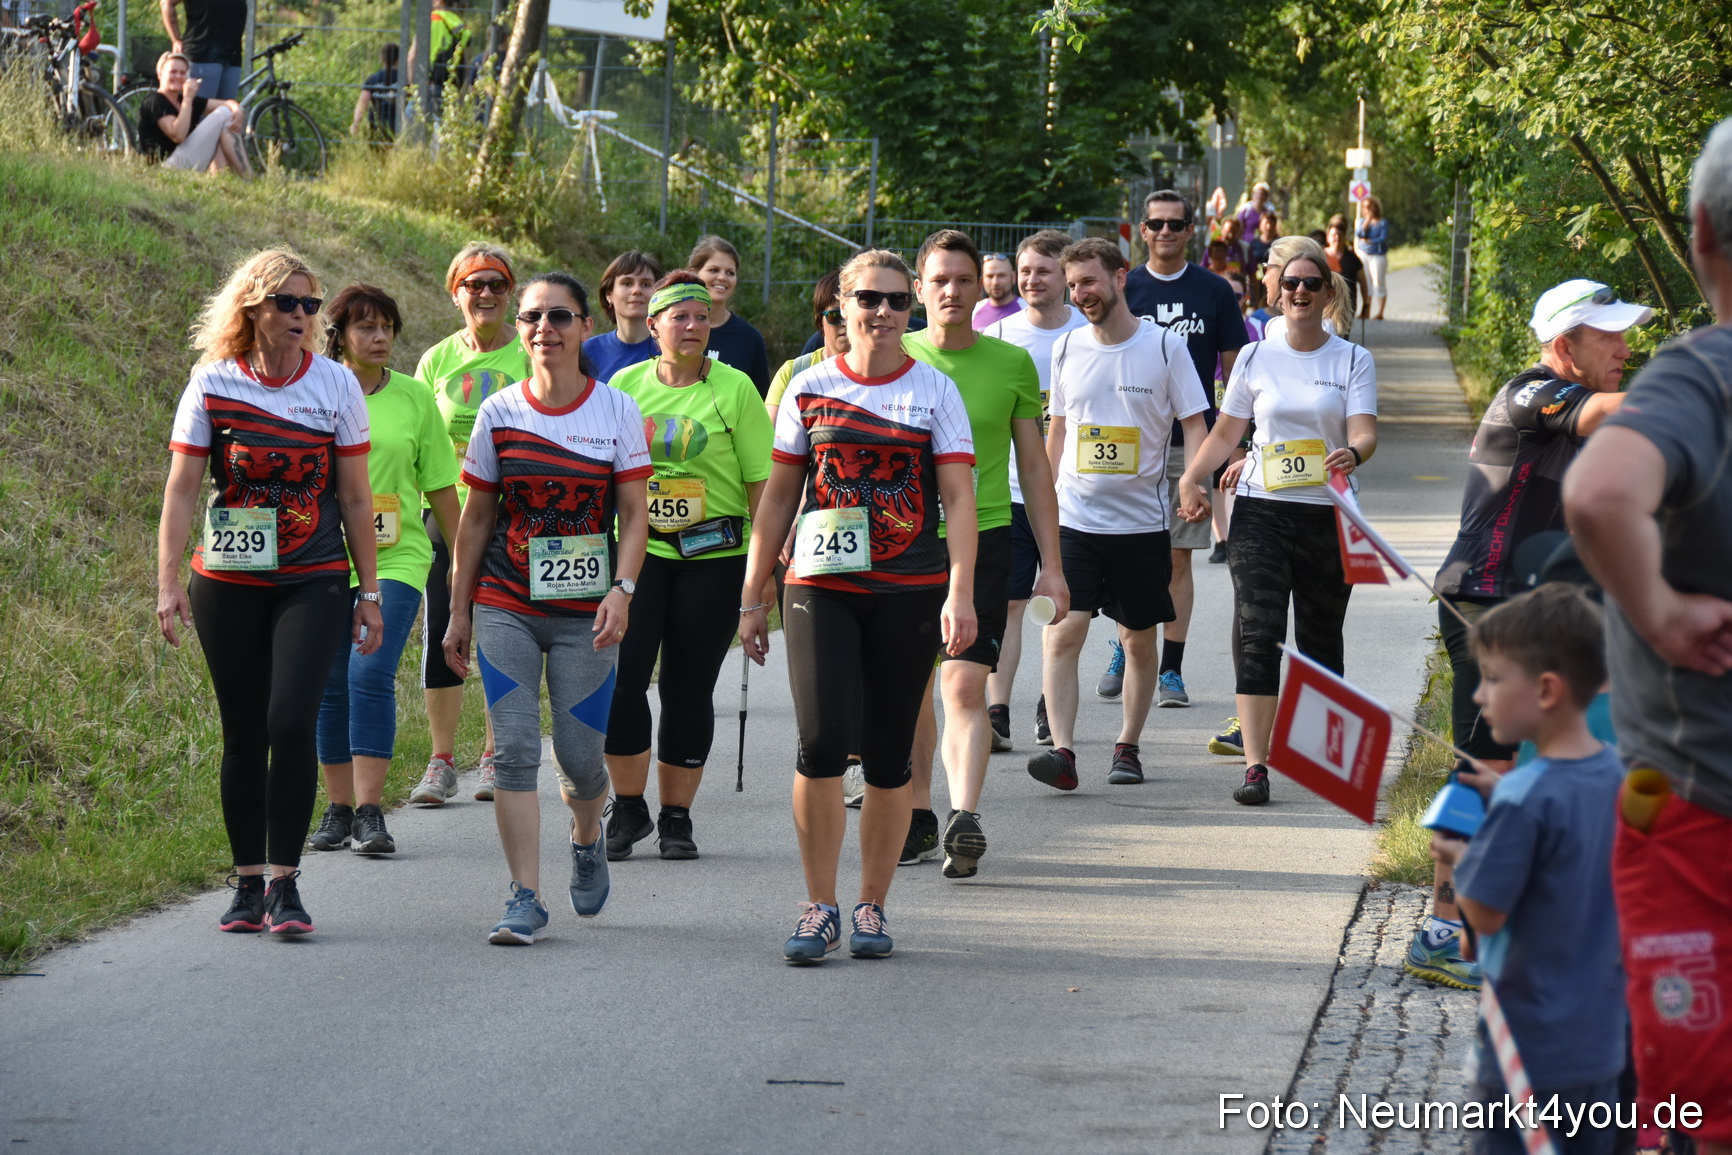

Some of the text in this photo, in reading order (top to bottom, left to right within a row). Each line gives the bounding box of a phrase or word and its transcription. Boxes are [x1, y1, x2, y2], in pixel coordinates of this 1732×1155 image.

[1118, 385, 1153, 394] auctores
[1313, 379, 1347, 391] auctores
[287, 405, 333, 417] NEUMARKT
[881, 403, 930, 414] NEUMARKT
[566, 435, 611, 446] NEUMARKT
[1094, 443, 1117, 460] 33
[1281, 456, 1306, 474] 30
[648, 498, 689, 518] 456
[374, 513, 385, 532] 4
[211, 530, 266, 553] 2239
[540, 557, 600, 582] 2259
[567, 580, 597, 588] Ana-Maria
